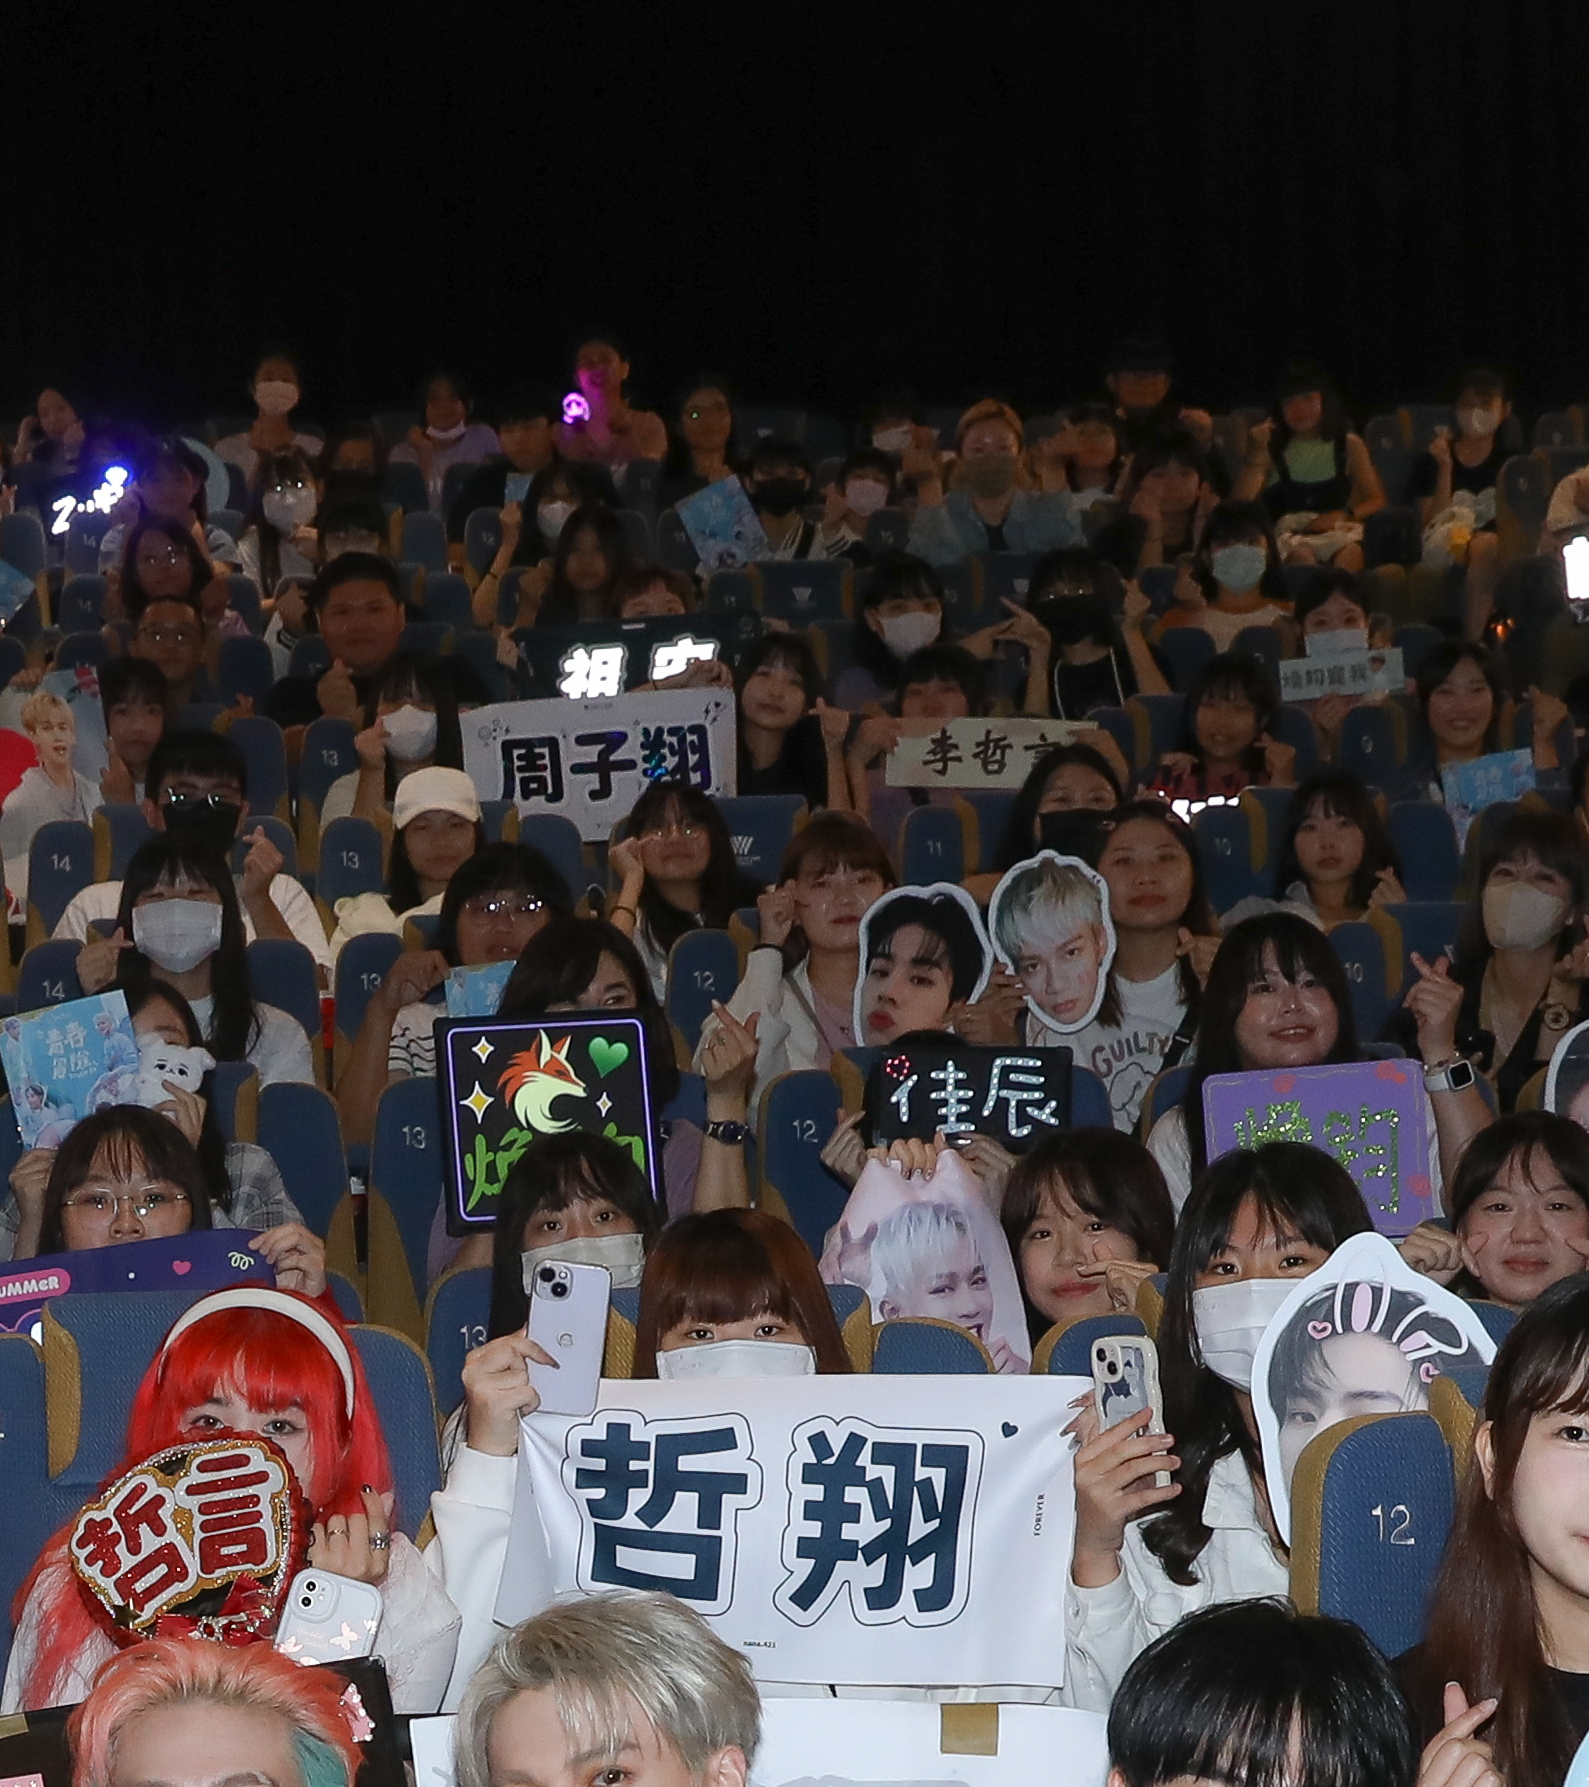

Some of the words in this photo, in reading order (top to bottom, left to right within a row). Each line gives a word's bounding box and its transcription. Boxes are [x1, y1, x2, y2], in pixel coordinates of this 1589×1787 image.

[321, 750, 339, 767] 13
[500, 723, 711, 802] 周子翔
[928, 839, 943, 857] 11
[51, 854, 72, 872] 14
[341, 851, 360, 869] 13
[360, 973, 382, 992] 13
[694, 971, 715, 991] 12
[1344, 962, 1364, 984] 10
[42, 980, 66, 1000] 14
[1091, 1031, 1172, 1077] GUILTY
[890, 1056, 1060, 1137] 佳辰
[402, 1126, 426, 1149] 13
[793, 1120, 818, 1143] 12
[576, 1422, 970, 1613] 哲翔
[1371, 1504, 1415, 1545] 12
[77, 1451, 272, 1622] 哲言
